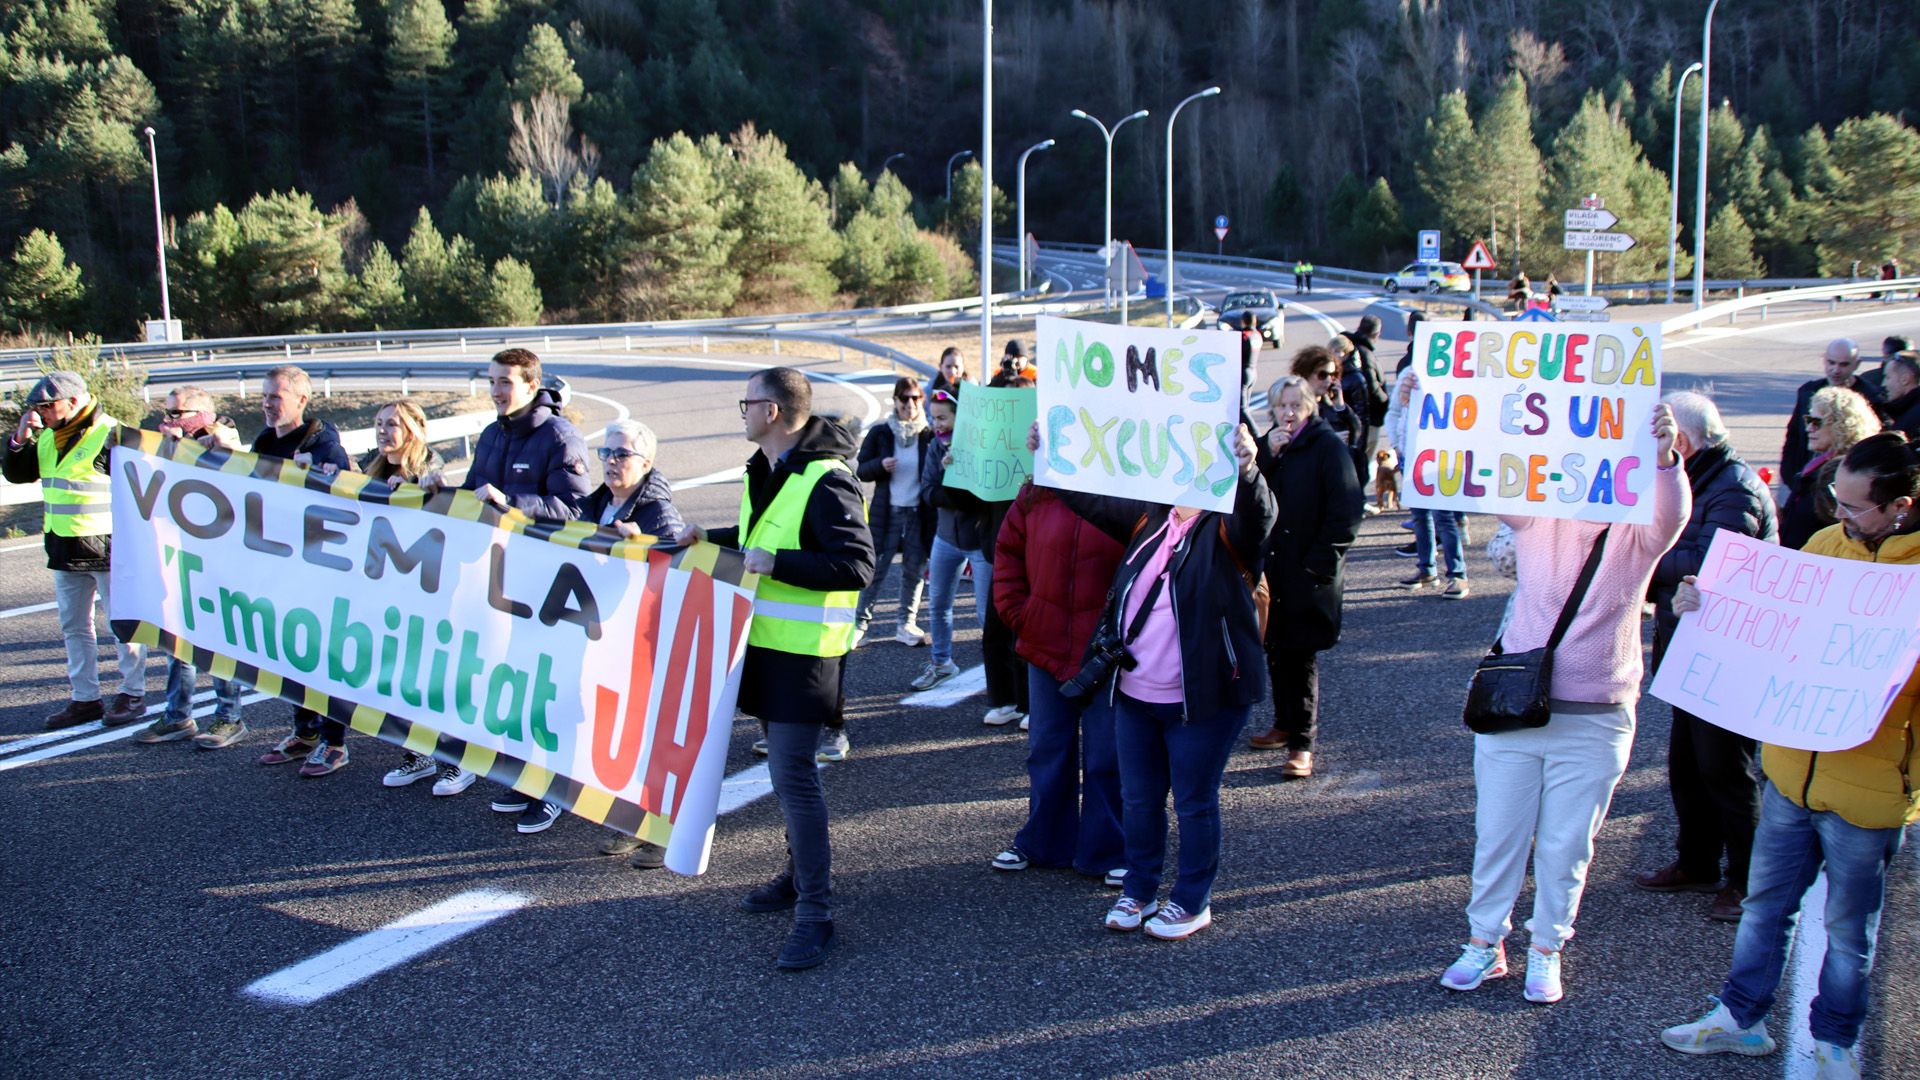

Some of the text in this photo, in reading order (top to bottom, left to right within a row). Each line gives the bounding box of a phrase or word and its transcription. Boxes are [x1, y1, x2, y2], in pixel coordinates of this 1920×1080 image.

[1055, 331, 1226, 403] NO MÉS
[1427, 326, 1656, 386] BERGUEDÀ
[993, 427, 1021, 451] AL
[1419, 383, 1624, 440] NO ÉS UN
[1047, 405, 1239, 497] EXCUSES
[1413, 449, 1641, 506] CUL-DE-SAC
[123, 460, 602, 641] VOLEM LA
[1715, 542, 1916, 617] PAGUEM COM
[1696, 589, 1801, 663] TOTHOM,
[1679, 652, 1723, 706] EL
